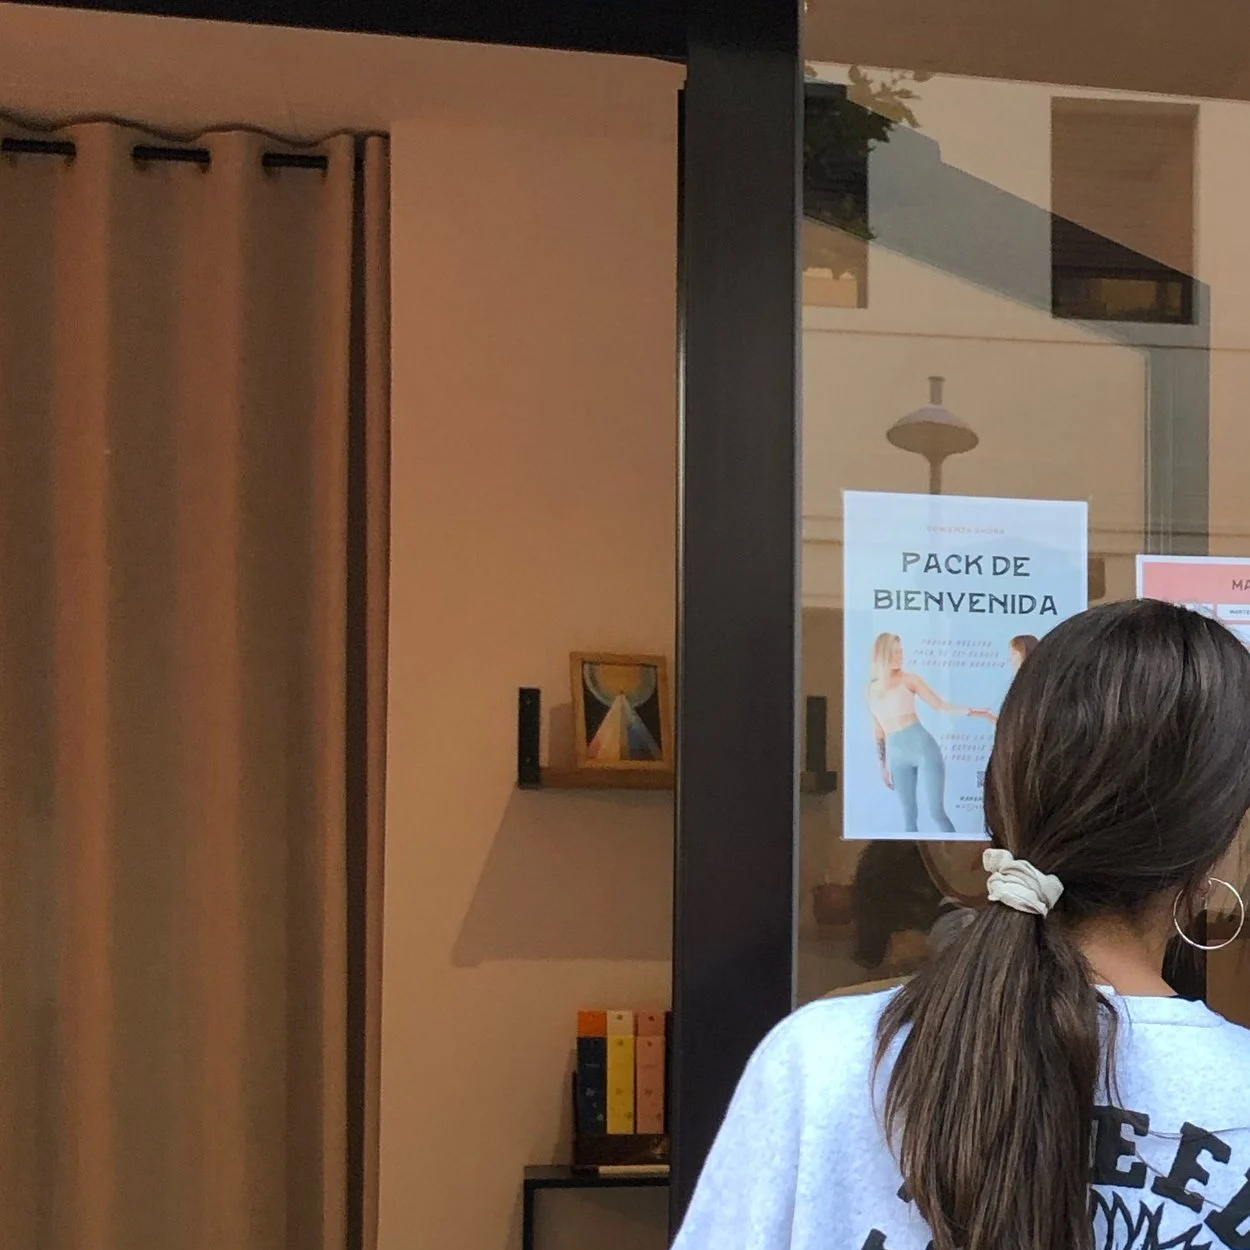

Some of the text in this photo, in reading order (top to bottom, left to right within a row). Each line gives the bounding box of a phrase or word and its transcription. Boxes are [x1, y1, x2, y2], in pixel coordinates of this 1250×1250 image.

[902, 551, 1031, 577] PACK DE
[873, 588, 1058, 616] BIENVENIDA
